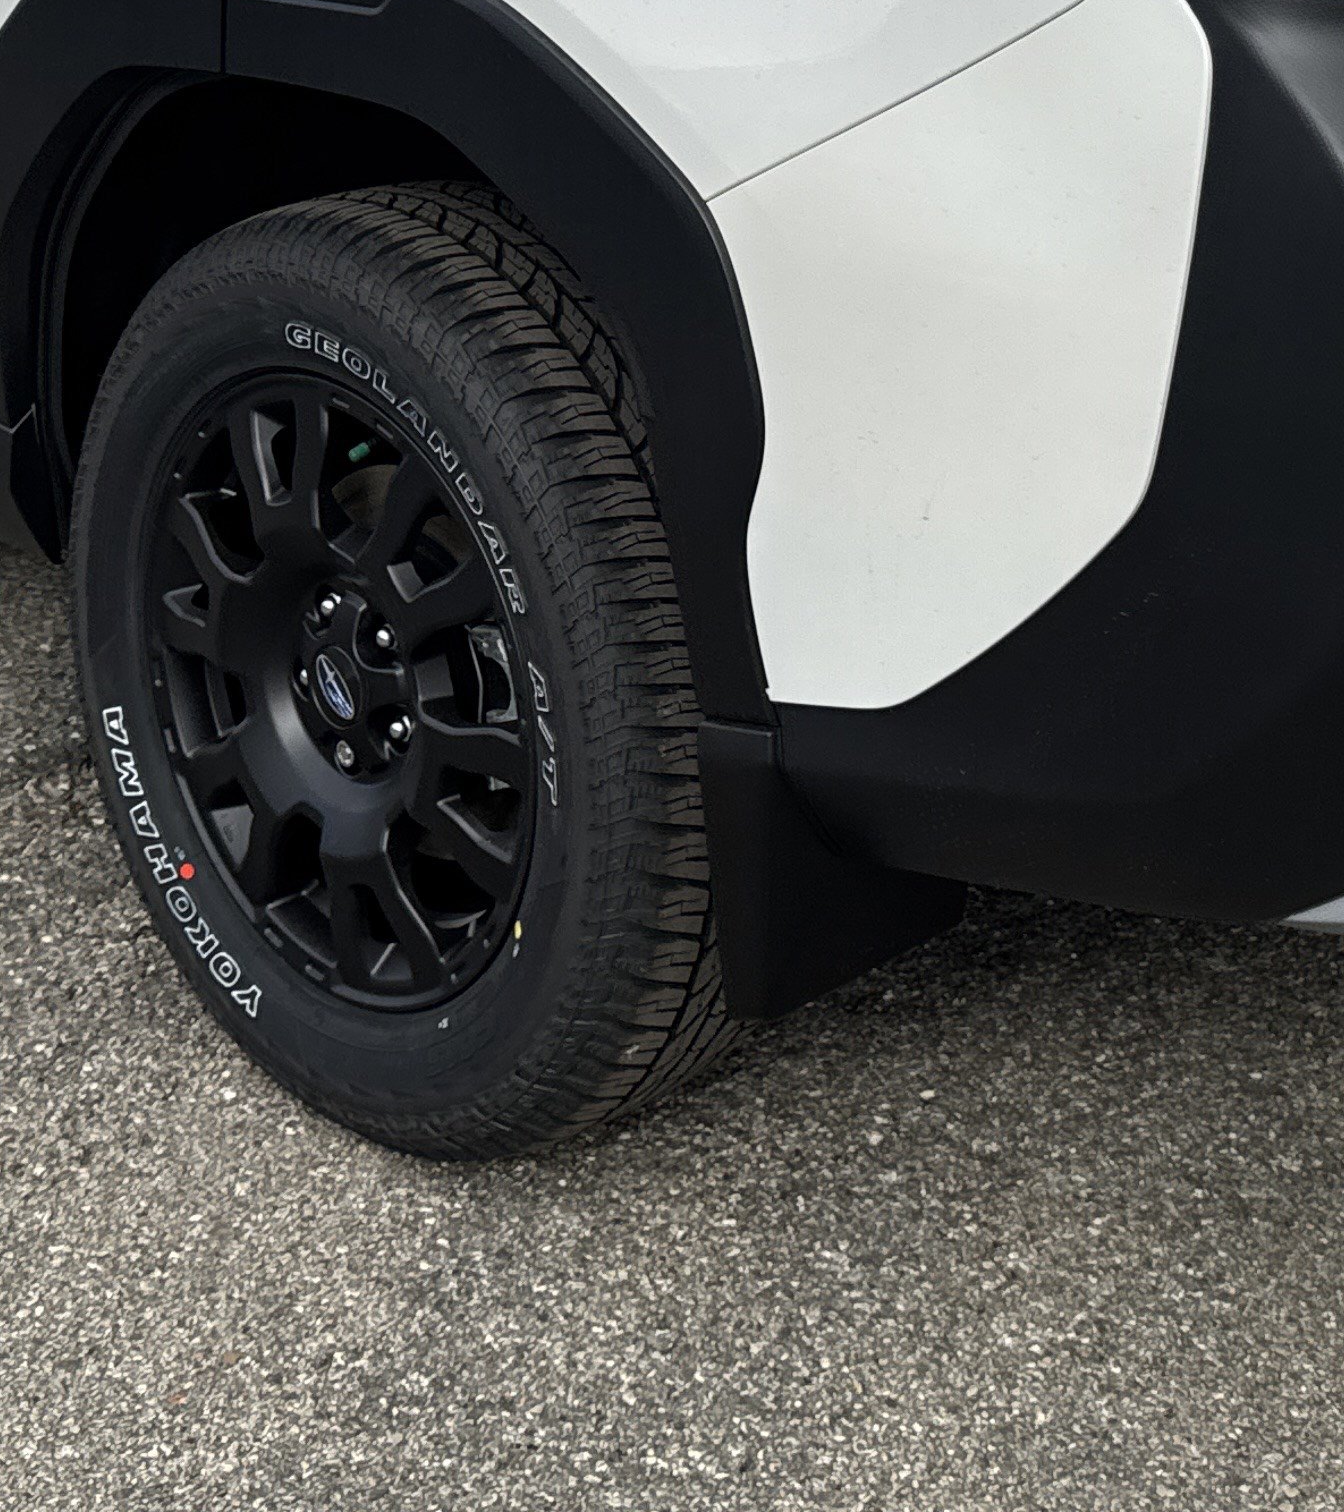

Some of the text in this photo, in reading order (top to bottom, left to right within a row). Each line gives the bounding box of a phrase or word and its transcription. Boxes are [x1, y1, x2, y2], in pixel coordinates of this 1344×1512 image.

[284, 321, 559, 807] GEOLANDAR A/T
[102, 706, 262, 1018] YOKOHAMA
